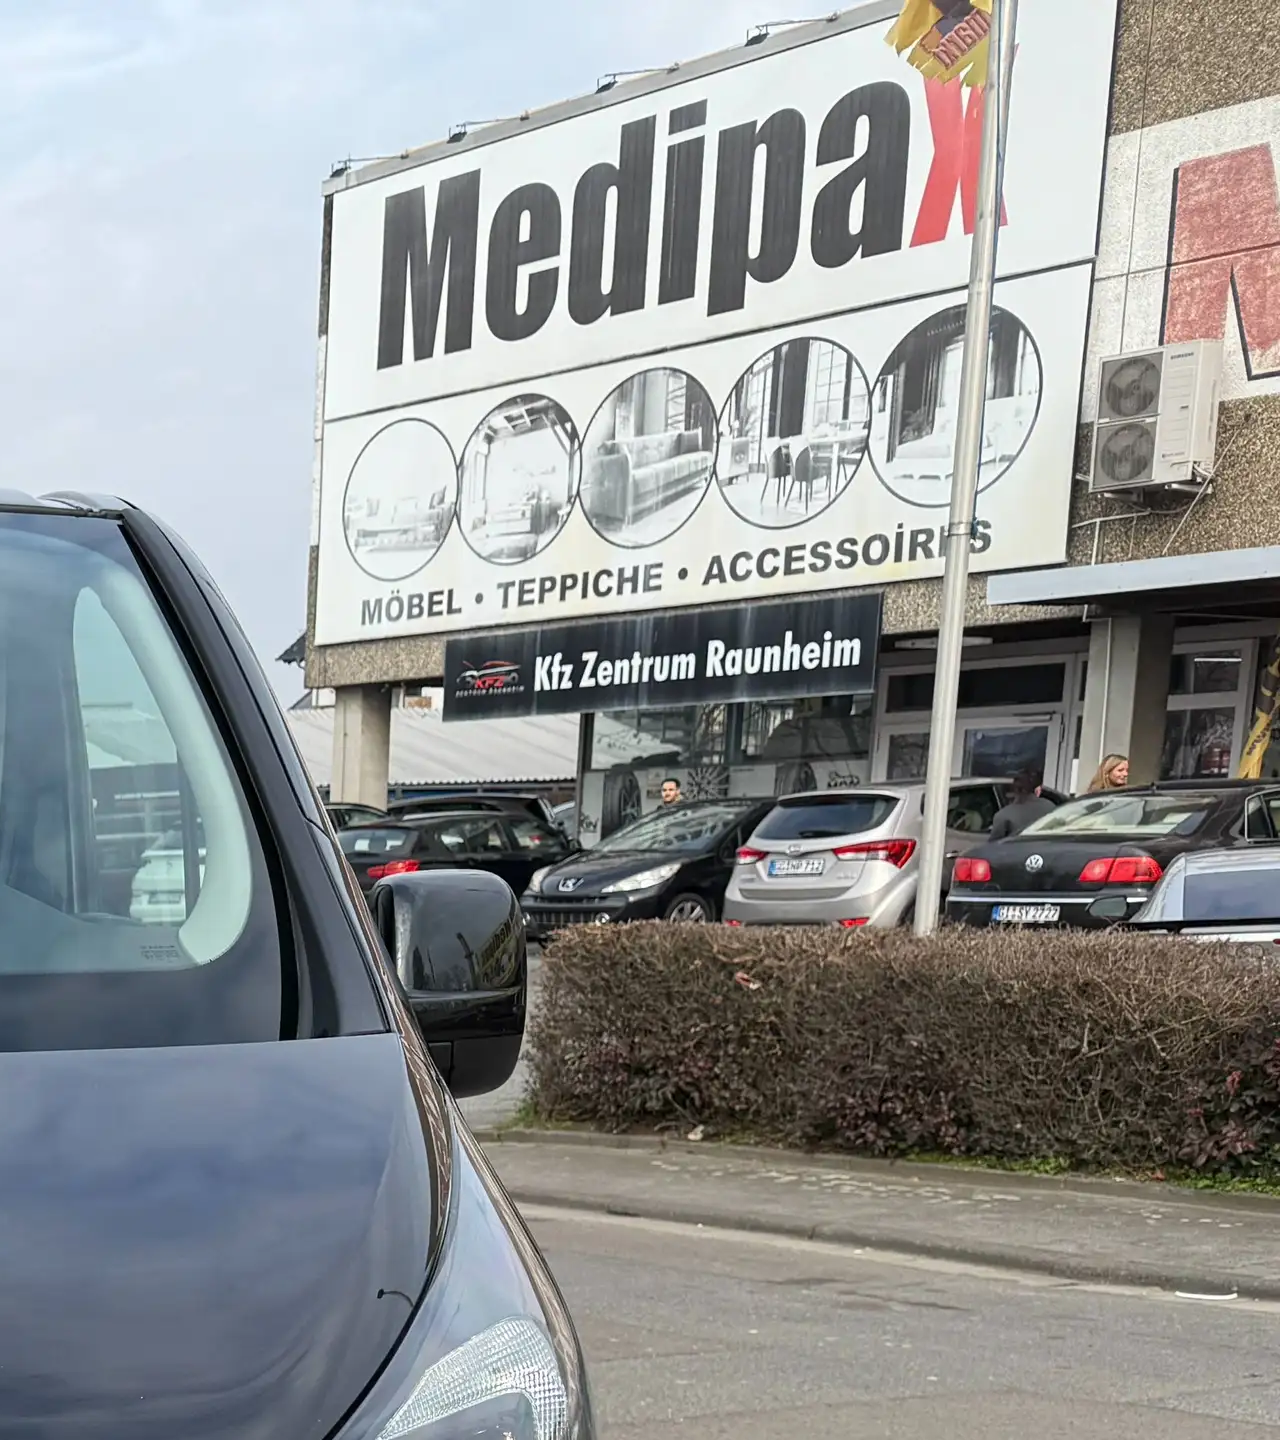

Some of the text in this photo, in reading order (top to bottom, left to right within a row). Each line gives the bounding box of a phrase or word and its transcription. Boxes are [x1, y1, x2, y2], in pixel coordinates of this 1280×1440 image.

[377, 43, 1019, 371] Medipax
[359, 585, 462, 627] MÖBEL
[497, 562, 664, 610] TEPPICHE
[534, 630, 861, 692] Kfz Zentrum Raunheim
